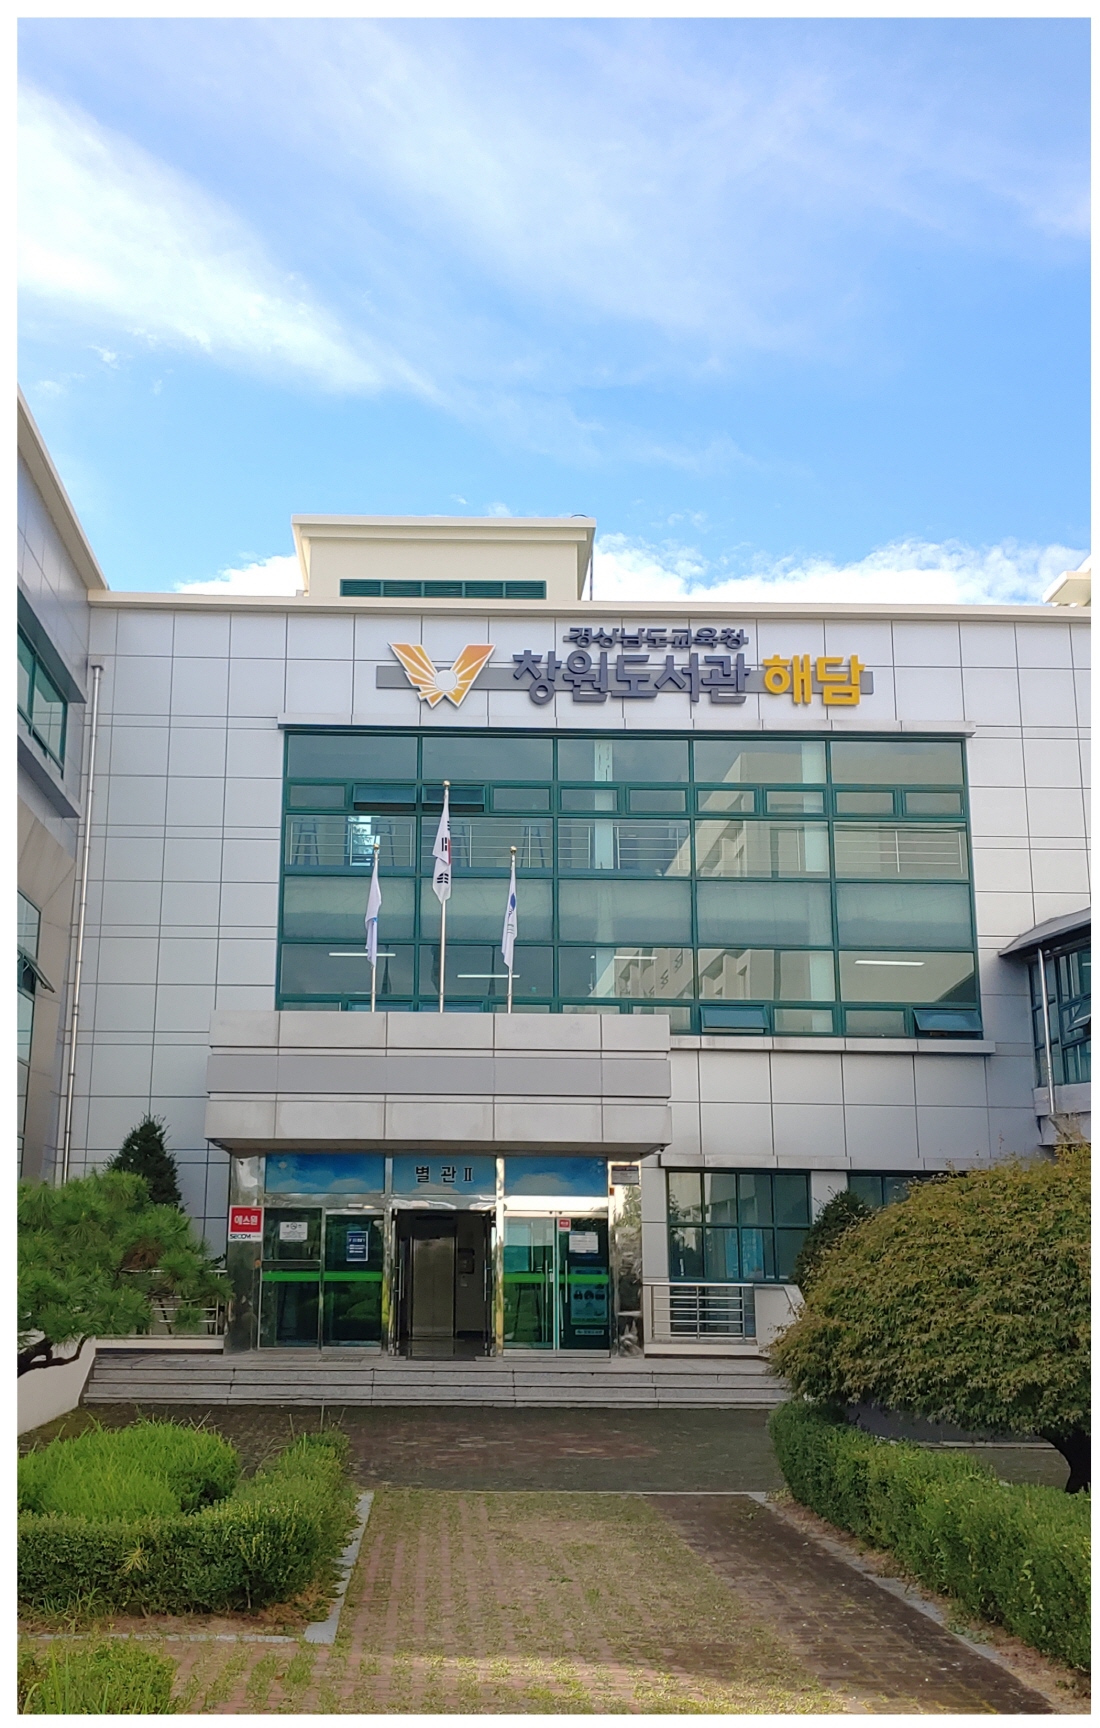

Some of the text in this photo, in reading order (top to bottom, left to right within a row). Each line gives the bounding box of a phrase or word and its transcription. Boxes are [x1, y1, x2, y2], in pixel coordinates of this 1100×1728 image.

[567, 627, 748, 650] 경상남도교육청
[512, 649, 866, 706] 창원도서관 해담
[234, 1215, 258, 1226] 에스원
